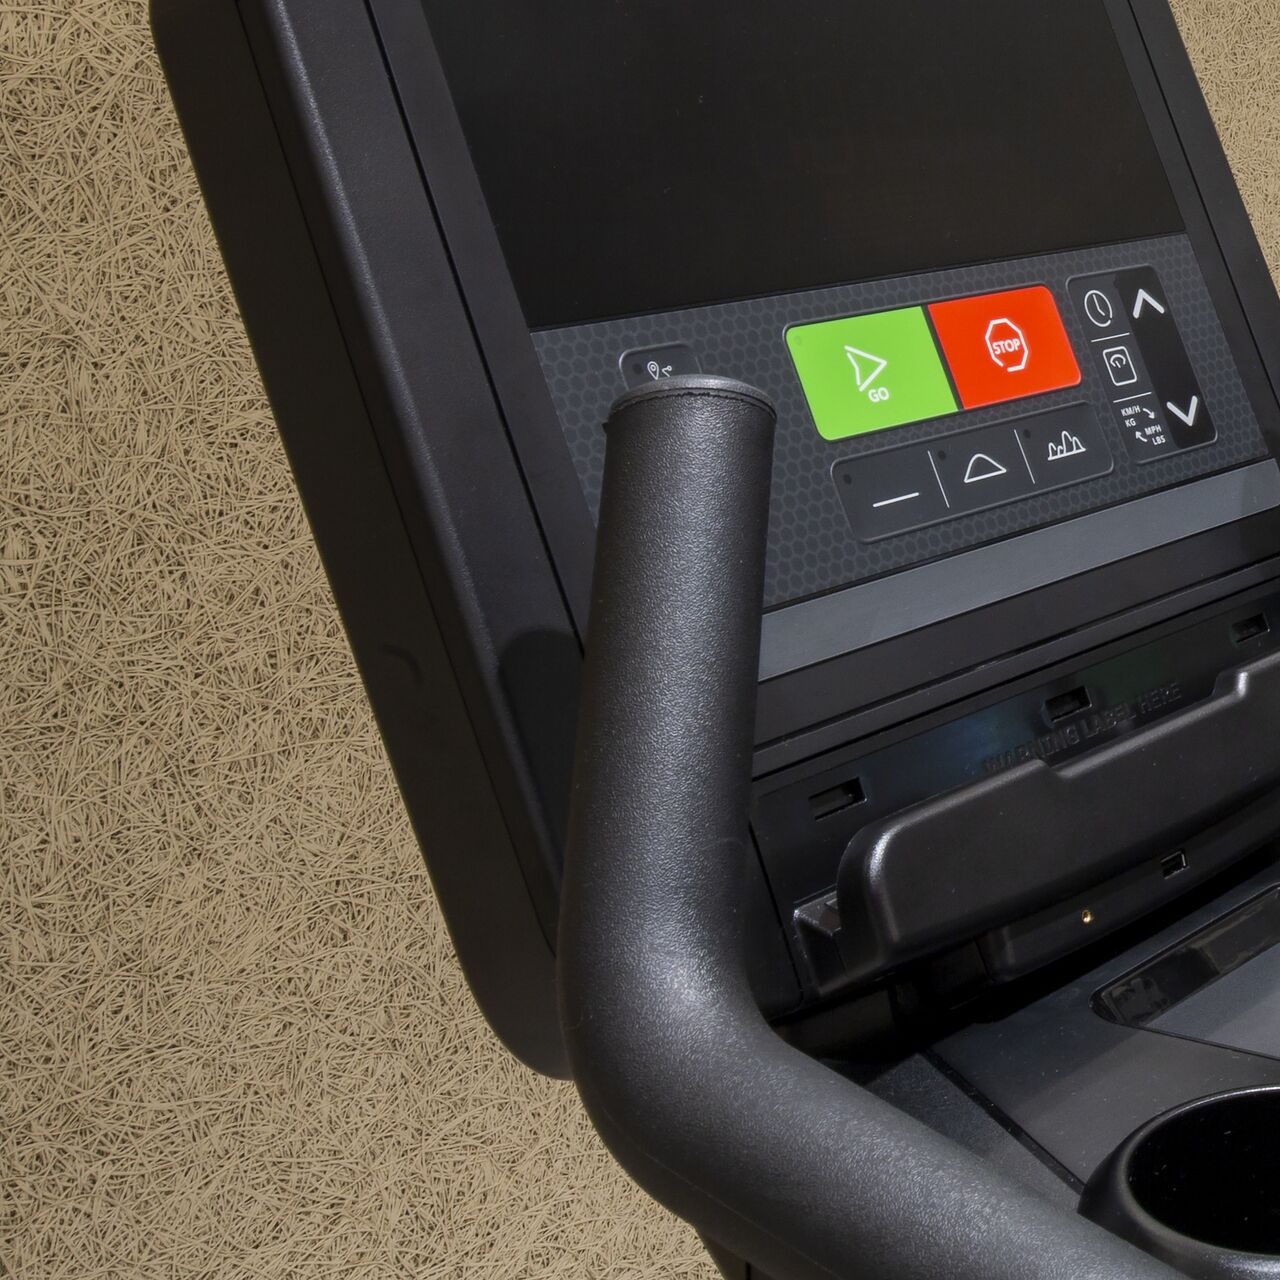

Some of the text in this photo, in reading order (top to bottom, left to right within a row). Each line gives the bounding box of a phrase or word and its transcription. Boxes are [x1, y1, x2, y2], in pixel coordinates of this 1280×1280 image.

[992, 337, 1021, 355] STOP
[867, 386, 890, 403] GO
[1121, 405, 1140, 416] KM/H
[1125, 418, 1136, 427] KG
[1144, 424, 1161, 435] MPH
[1152, 435, 1165, 445] LBS
[1080, 702, 1138, 739] LABEL
[1136, 681, 1182, 715] HERE
